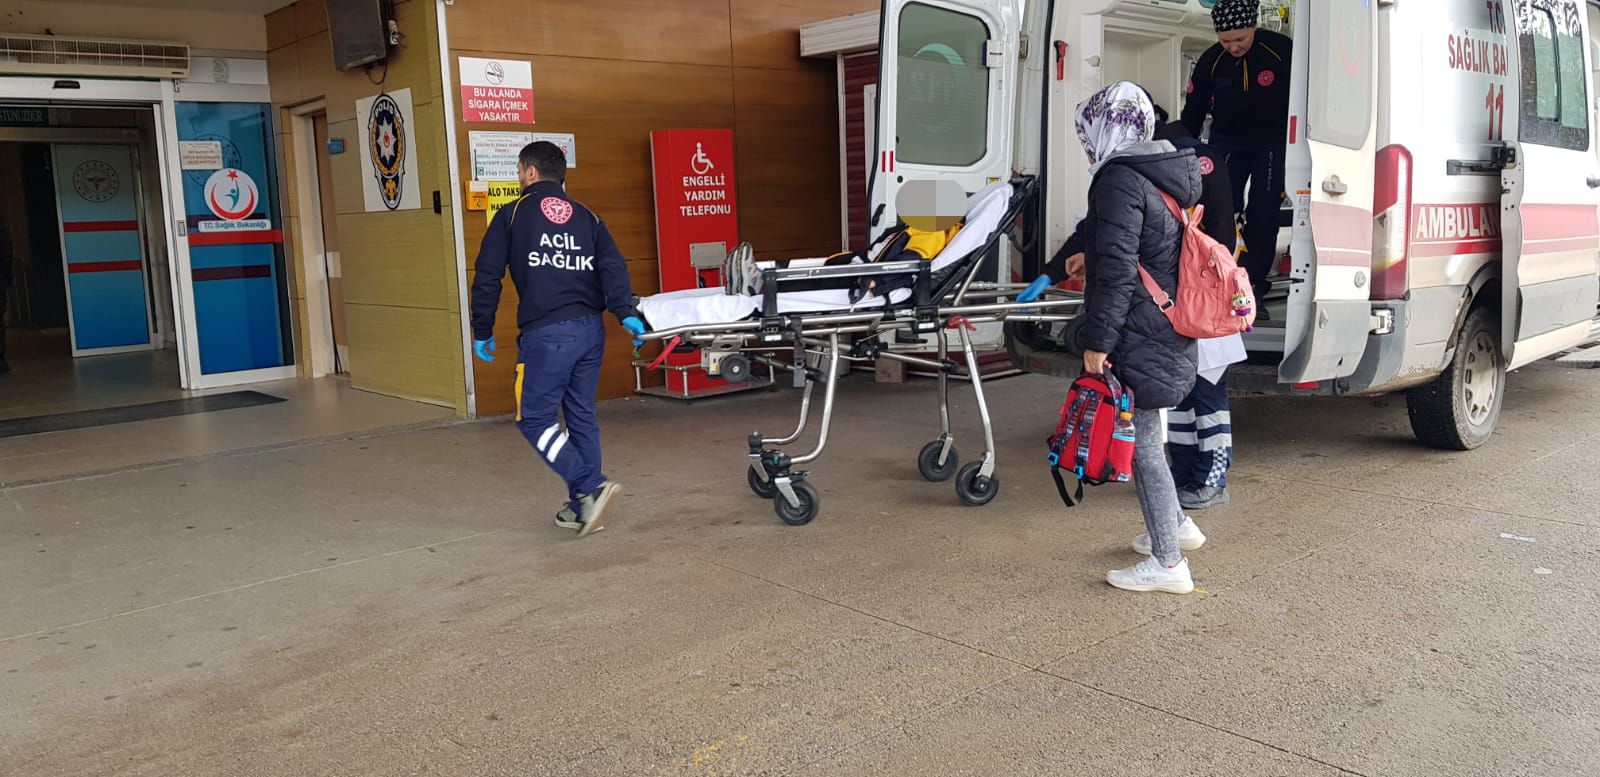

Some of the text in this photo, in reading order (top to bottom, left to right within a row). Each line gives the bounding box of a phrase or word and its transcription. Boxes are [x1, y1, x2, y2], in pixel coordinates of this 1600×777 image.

[1448, 27, 1508, 77] SAĞLIK BA
[473, 87, 522, 99] BU ALANDA
[468, 98, 528, 112] SİGARA İÇMEK
[1486, 83, 1504, 141] 11
[479, 111, 520, 122] YASAKTIR
[683, 173, 725, 187] ENGELLİ
[488, 187, 501, 197] ALO
[502, 187, 520, 197] TAKS
[684, 190, 725, 201] YARDIM
[680, 205, 731, 216] TELEFONU
[1415, 207, 1501, 239] AMBULAN
[540, 233, 581, 250] ACİL
[528, 250, 594, 271] SAĞLIK
